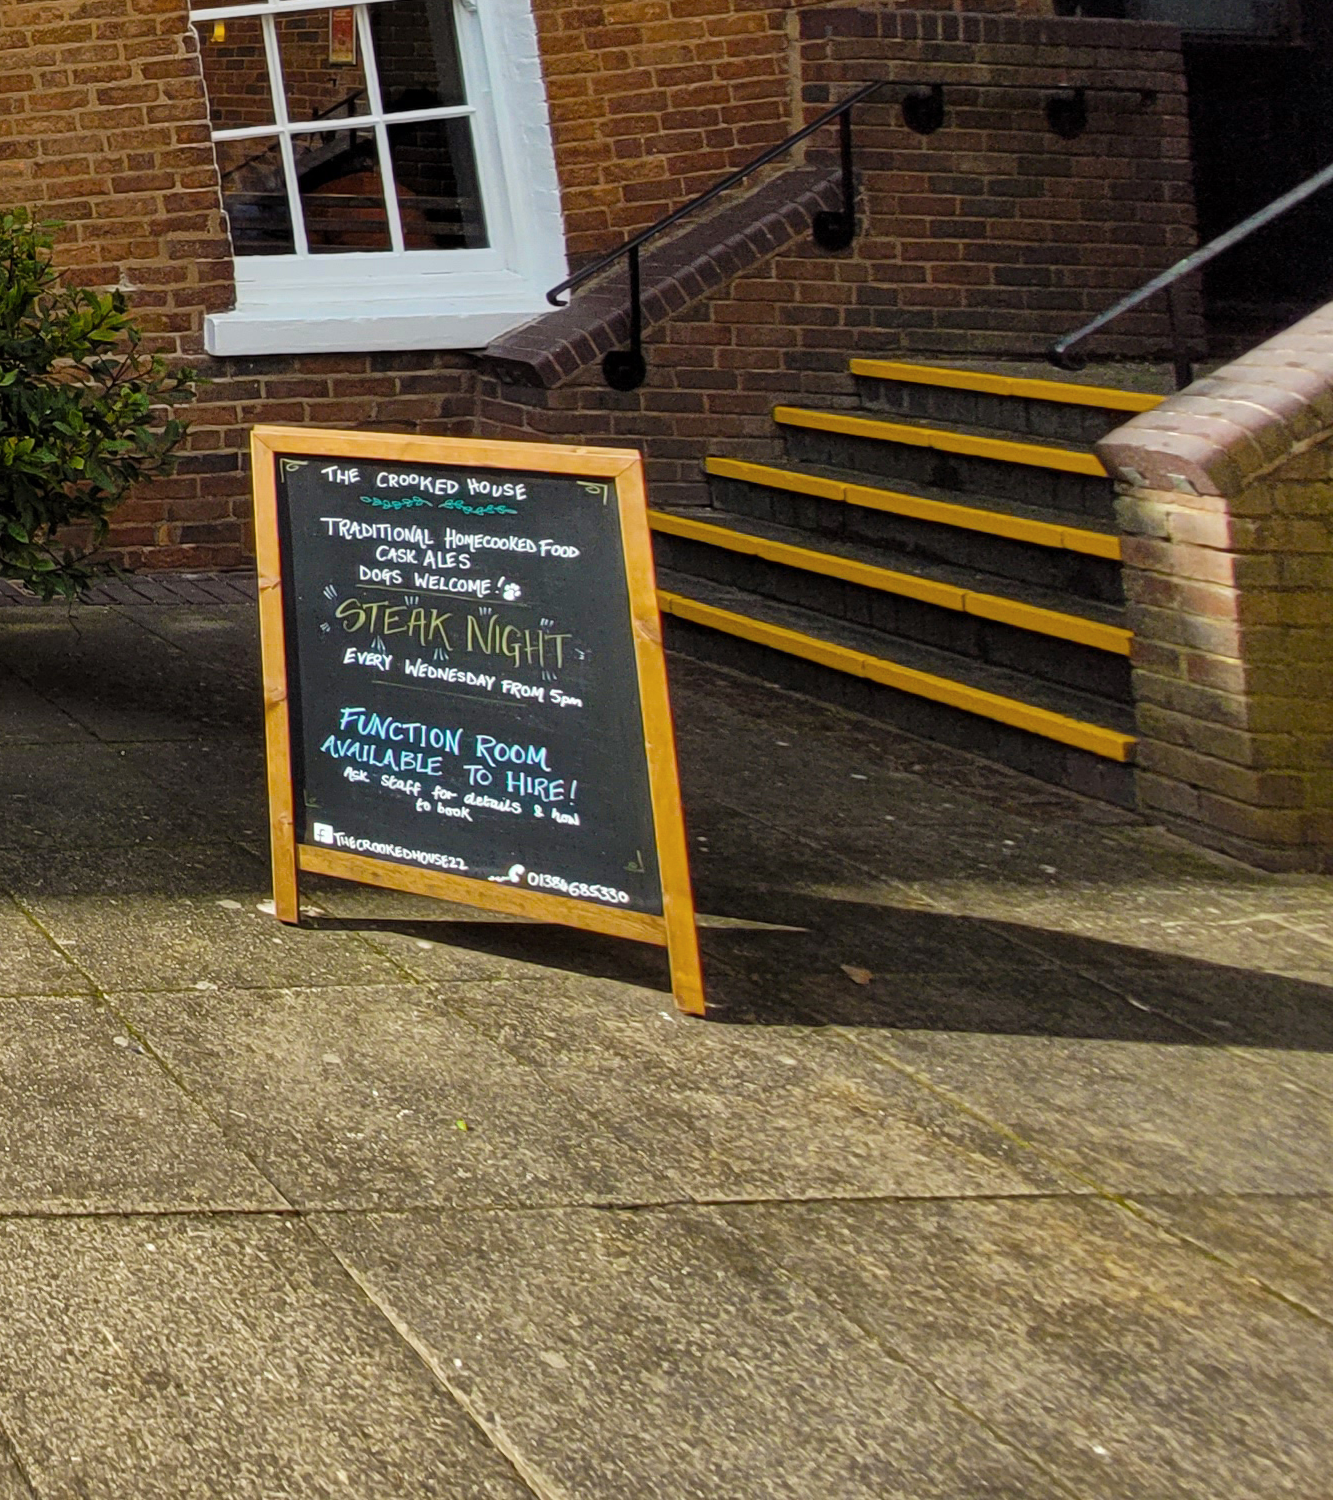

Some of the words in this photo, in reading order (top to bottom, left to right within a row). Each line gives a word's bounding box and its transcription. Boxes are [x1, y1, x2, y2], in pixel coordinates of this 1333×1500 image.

[321, 465, 361, 485] THE
[376, 472, 459, 495] CROOKED
[467, 478, 527, 501] HOUSE
[320, 517, 434, 549] TRADITIONAL
[445, 528, 537, 553] HOMECOOKED
[539, 539, 580, 558] FOOD
[376, 545, 418, 564] CASK
[423, 551, 471, 569] ALES
[359, 565, 402, 585] DOGS
[335, 598, 453, 652] STEAK
[467, 613, 572, 669] NIGHT
[343, 648, 393, 671] EVERY
[405, 658, 496, 691] WEDNESDAY
[502, 679, 544, 703] FROM
[549, 690, 583, 708] 5pm
[340, 707, 463, 756] FUNCTION
[476, 735, 551, 772] ROOM
[320, 735, 443, 776] AVAILABLE
[463, 764, 492, 786] TO
[506, 771, 577, 806] HIRE!
[344, 766, 370, 783] Ask
[381, 775, 421, 797] staff
[432, 785, 458, 800] for
[464, 792, 522, 814] details
[534, 805, 544, 818] &
[551, 808, 580, 826] how
[416, 798, 431, 812] to
[437, 801, 473, 822] book
[333, 832, 469, 871] THECROOKEDHOUSE22
